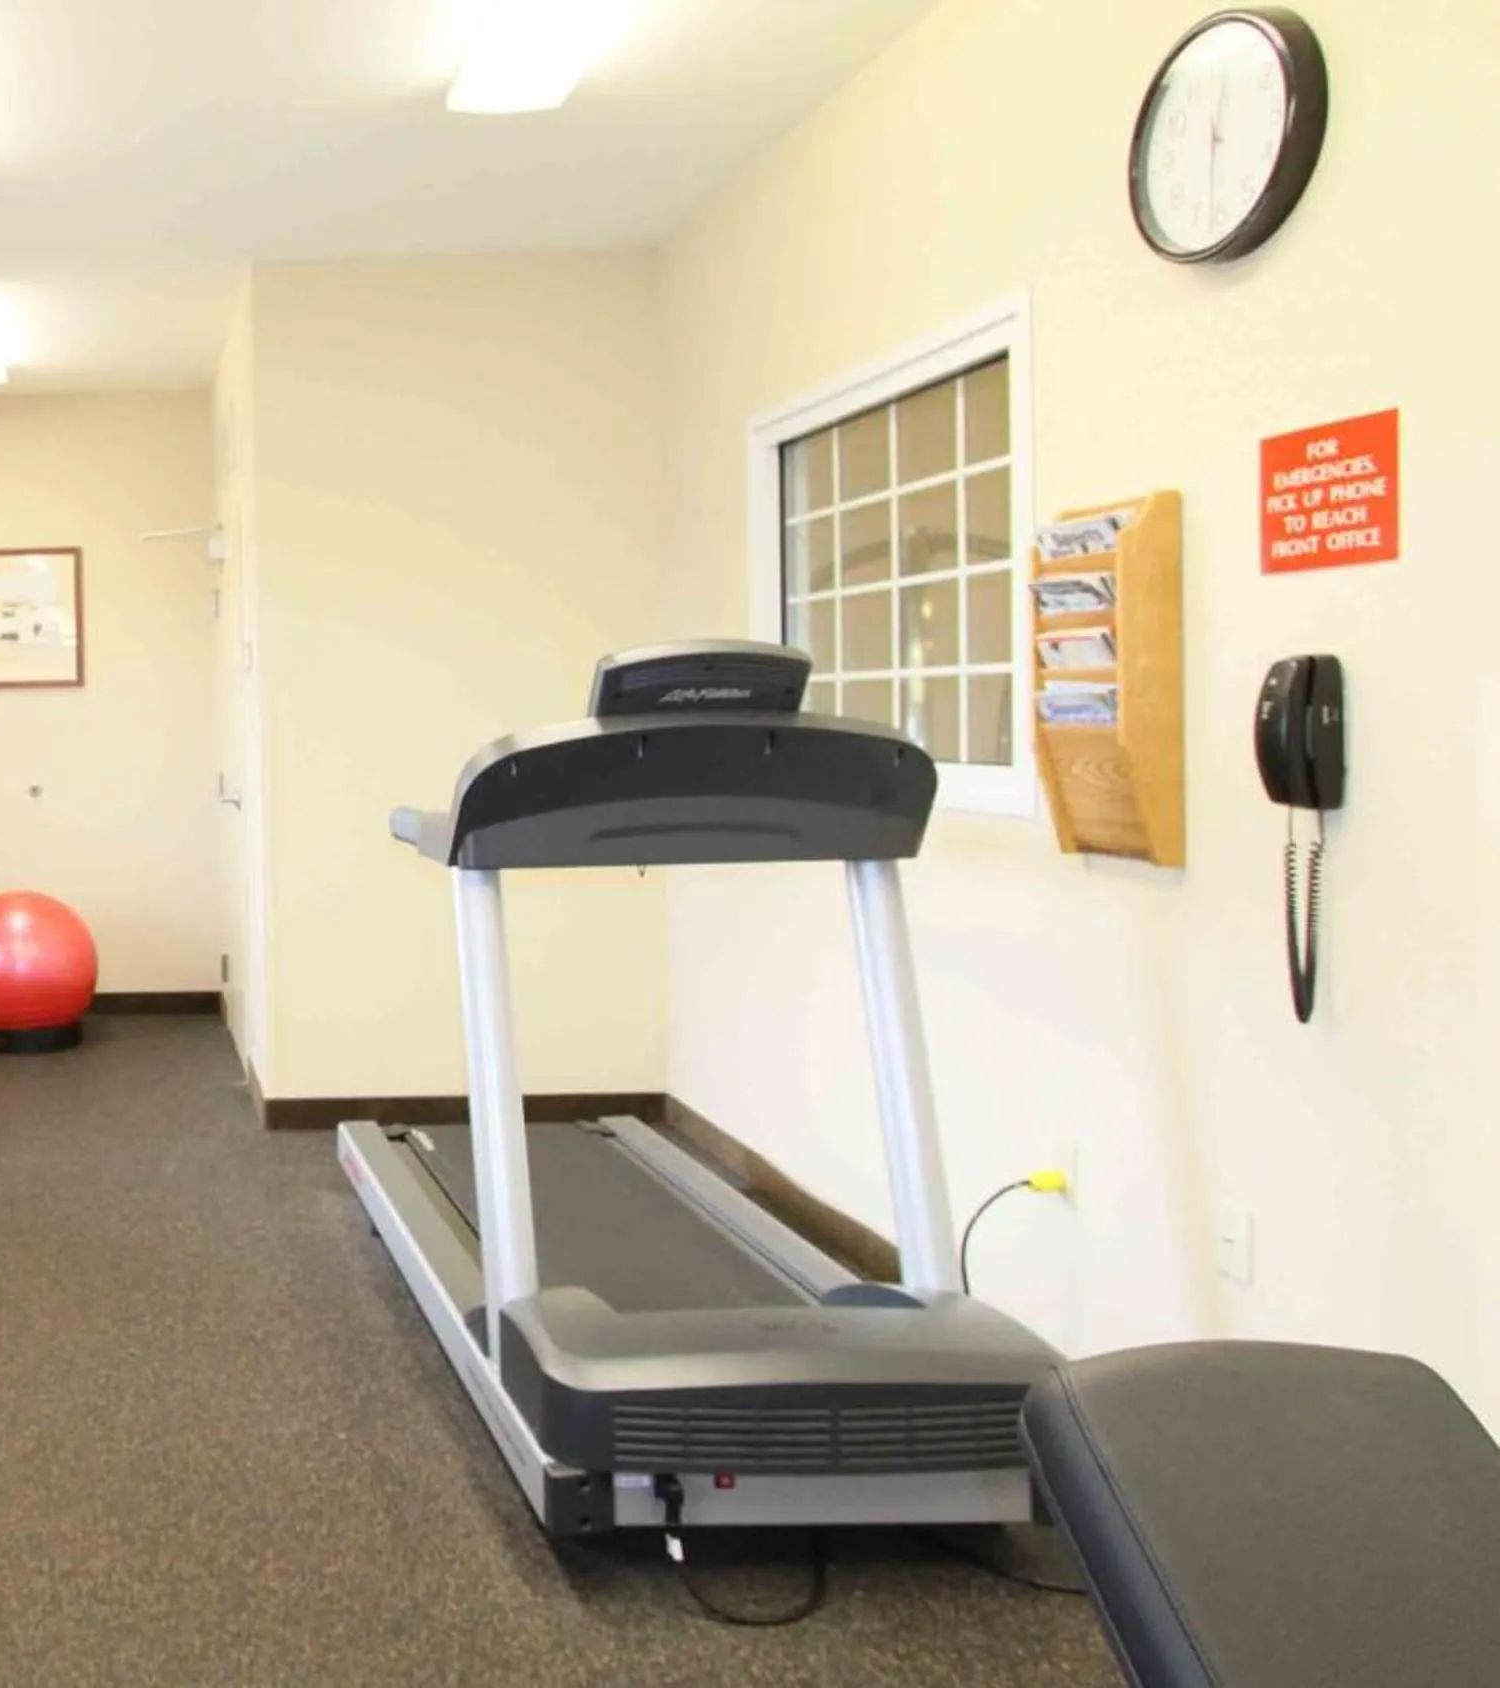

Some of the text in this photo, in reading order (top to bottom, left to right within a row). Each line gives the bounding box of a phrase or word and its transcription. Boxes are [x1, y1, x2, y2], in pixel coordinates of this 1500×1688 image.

[1306, 438, 1339, 461] FOR
[1266, 476, 1388, 513] PICK UP PHONE
[1283, 505, 1369, 534] TO REACH
[1271, 527, 1381, 559] FRONT OFFICE
